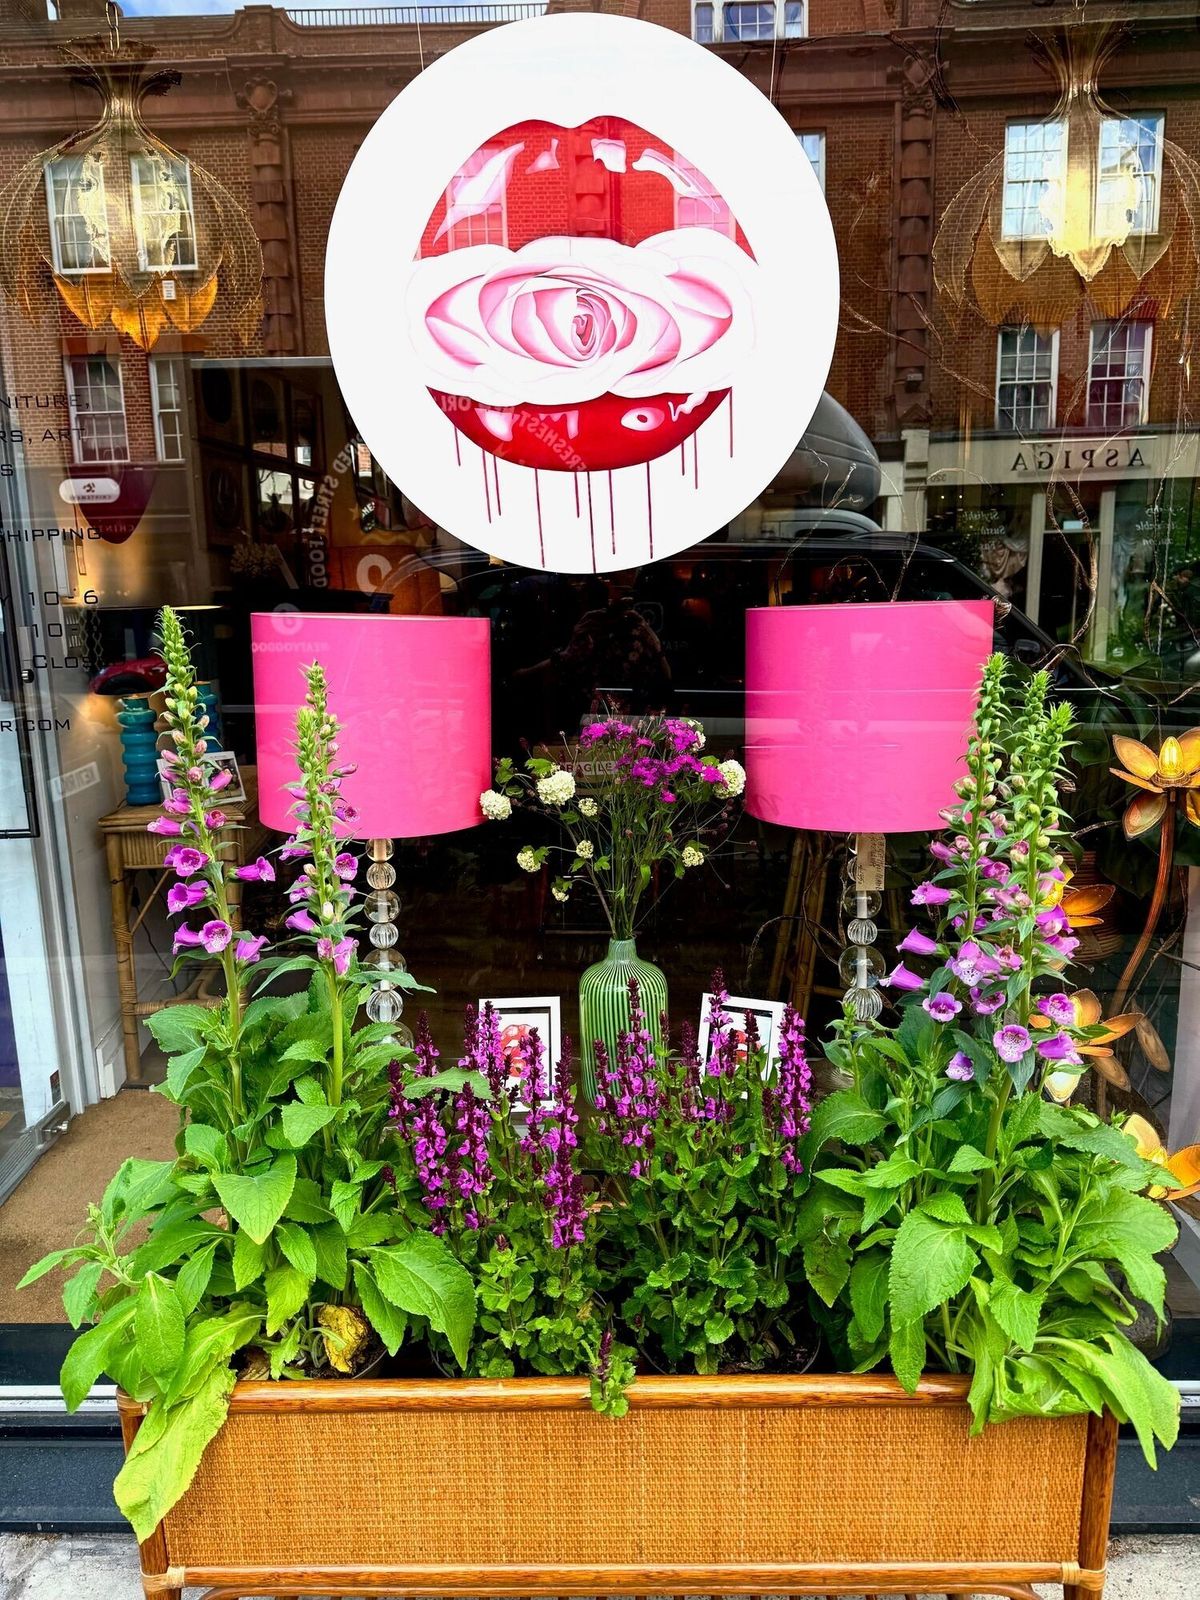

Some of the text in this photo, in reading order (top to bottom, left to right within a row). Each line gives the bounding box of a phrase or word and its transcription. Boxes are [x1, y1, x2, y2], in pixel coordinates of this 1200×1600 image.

[42, 428, 86, 443] ART
[28, 591, 60, 606] 10
[83, 589, 99, 605] 6
[31, 623, 63, 638] 10
[560, 762, 613, 773] RAGLE
